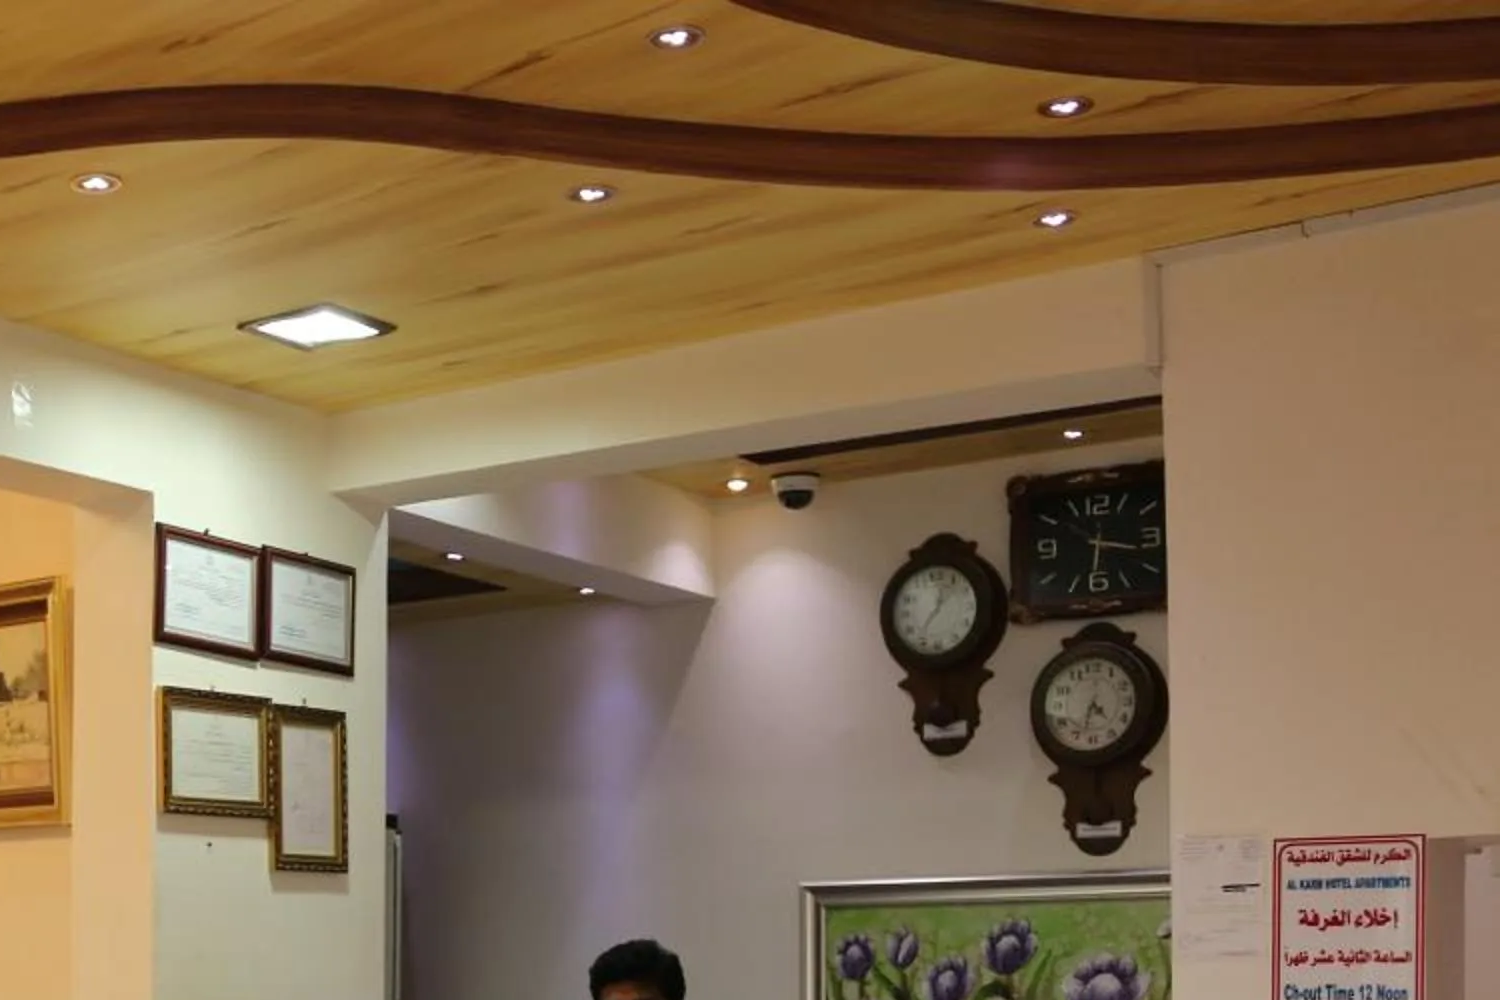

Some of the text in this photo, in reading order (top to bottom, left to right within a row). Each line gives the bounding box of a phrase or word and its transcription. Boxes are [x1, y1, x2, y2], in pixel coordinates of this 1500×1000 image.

[1085, 494, 1110, 516] 12
[1140, 526, 1161, 549] 3
[1037, 538, 1058, 559] 9
[1088, 571, 1110, 593] 6
[1285, 849, 1335, 867] الفندقية
[1325, 877, 1352, 889] HOTEL
[1355, 875, 1411, 889] APARTMENTS
[1297, 908, 1351, 932] الغرفة
[1337, 948, 1372, 967] الثانية
[1373, 949, 1412, 963] الساعة
[1325, 983, 1355, 1000] Time
